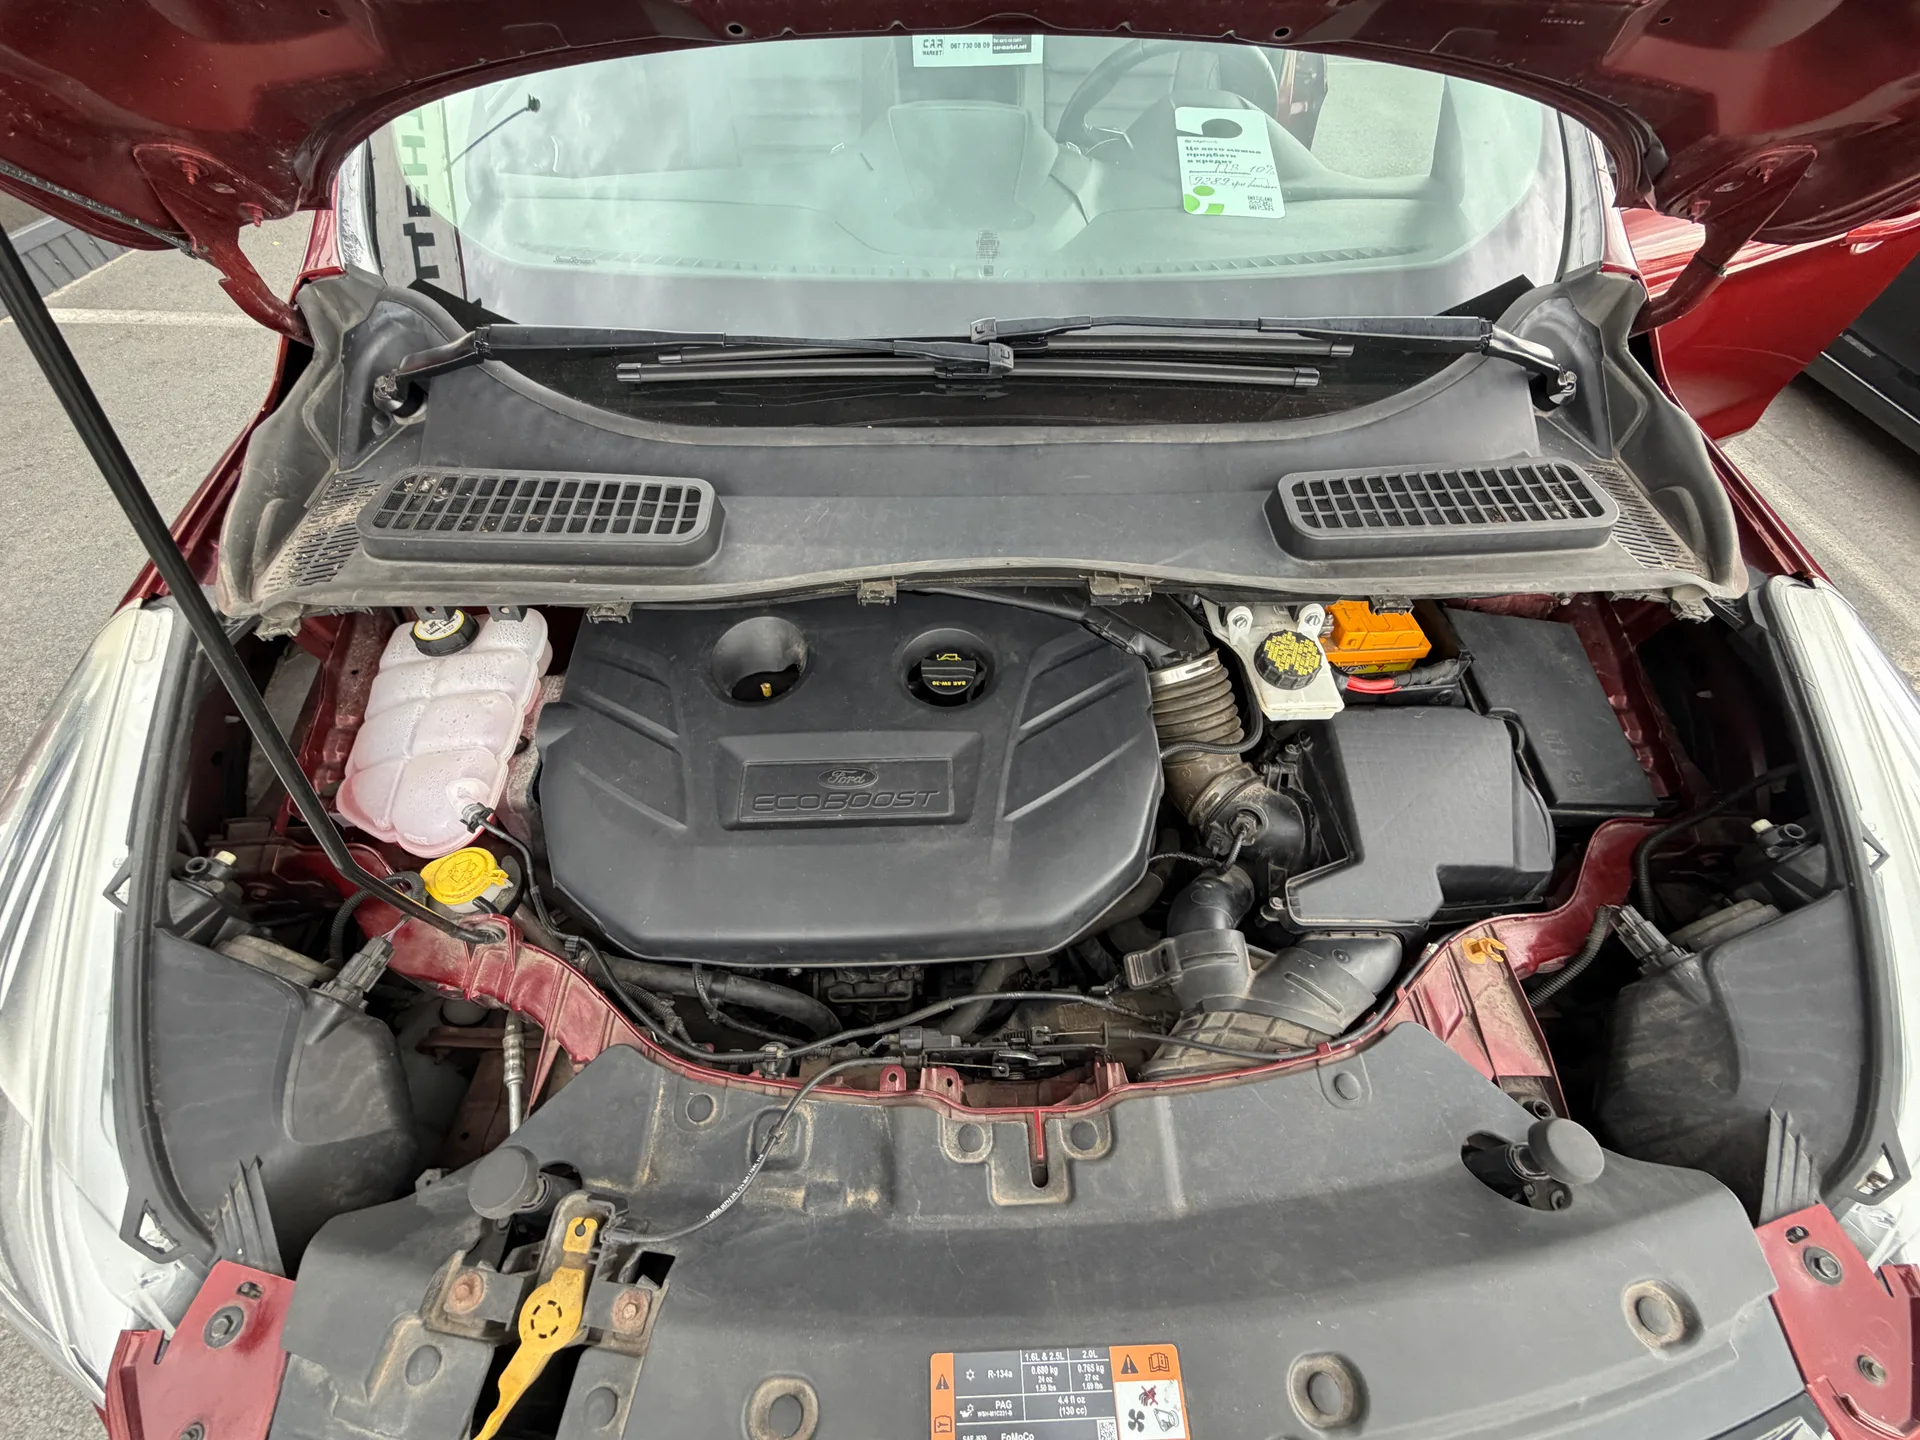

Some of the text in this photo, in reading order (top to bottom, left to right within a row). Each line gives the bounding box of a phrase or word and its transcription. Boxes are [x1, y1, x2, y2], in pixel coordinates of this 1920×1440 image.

[923, 39, 943, 48] CAR
[828, 769, 865, 785] Ford
[1025, 1351, 1065, 1361] 1.6L & 2.5L
[1082, 1349, 1098, 1359] 2.0L
[987, 1369, 1013, 1379] R-134a
[1049, 1365, 1058, 1376] kg
[1095, 1363, 1105, 1375] kg
[1047, 1384, 1057, 1392] lbs
[1094, 1382, 1104, 1390] lbs
[995, 1400, 1012, 1410] PAG
[1057, 1395, 1086, 1405] 4.4 fl oz
[1059, 1405, 1088, 1418] (130 cc)
[1001, 1431, 1035, 1440] FoMoCo
